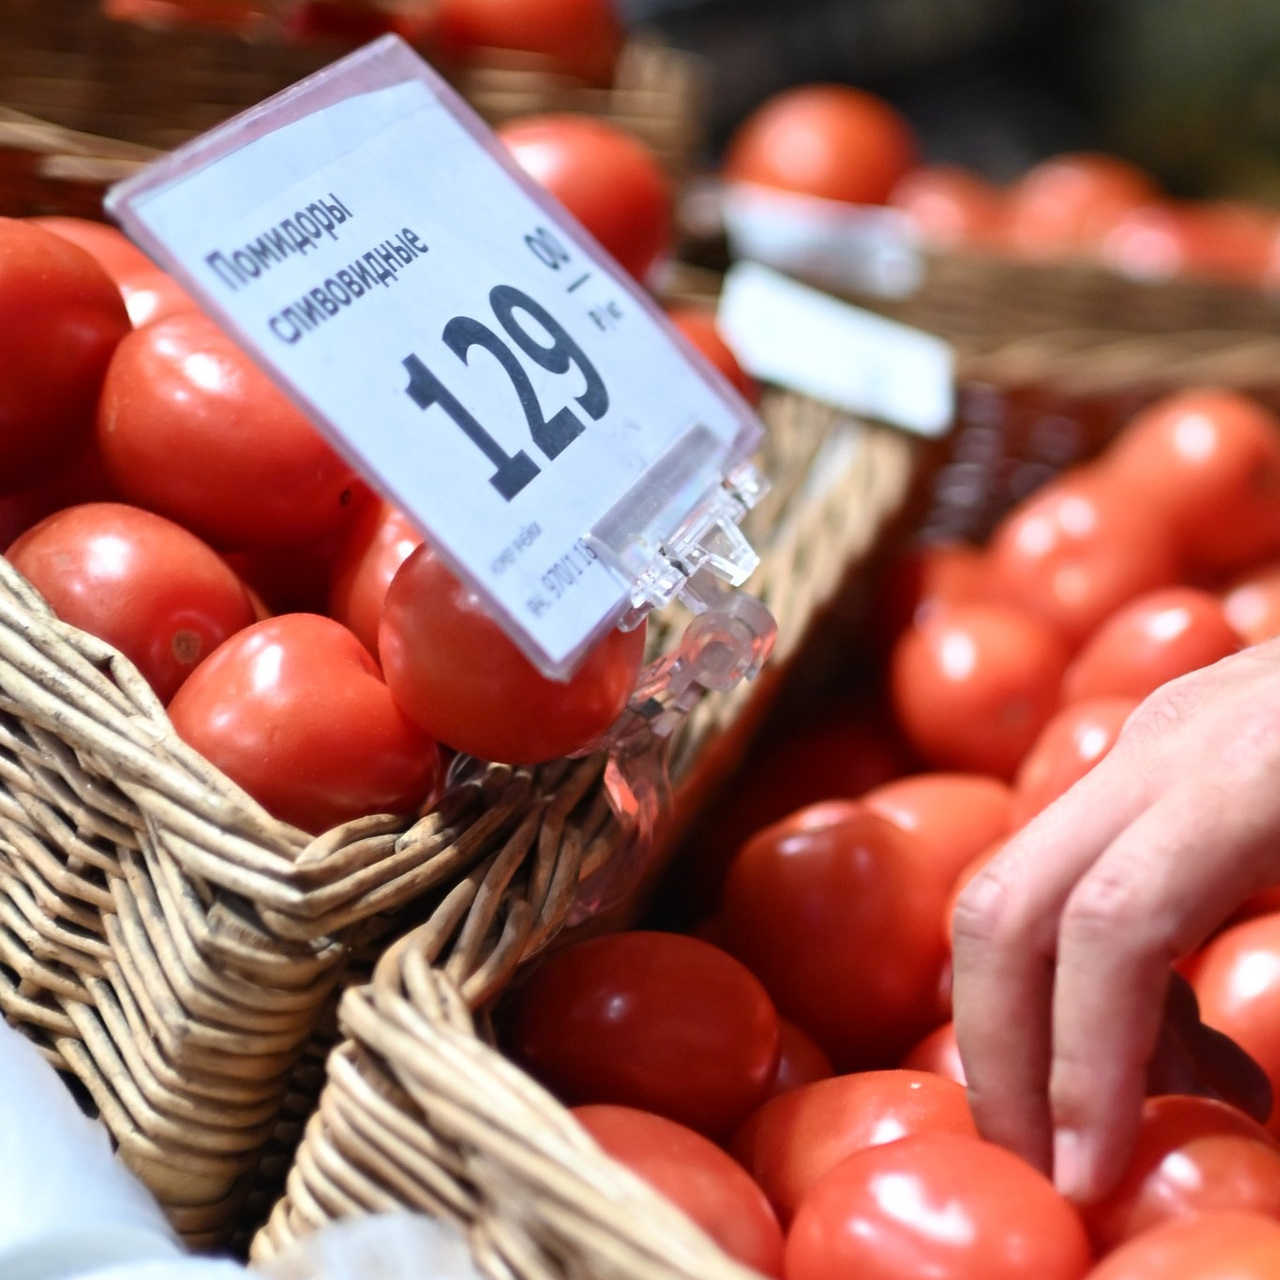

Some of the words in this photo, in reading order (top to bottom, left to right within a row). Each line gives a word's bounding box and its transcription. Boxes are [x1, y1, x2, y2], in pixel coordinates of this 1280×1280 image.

[203, 192, 353, 291] Помидоры
[268, 228, 429, 345] сливовидные
[524, 227, 570, 271] 00
[401, 284, 610, 503] 129
